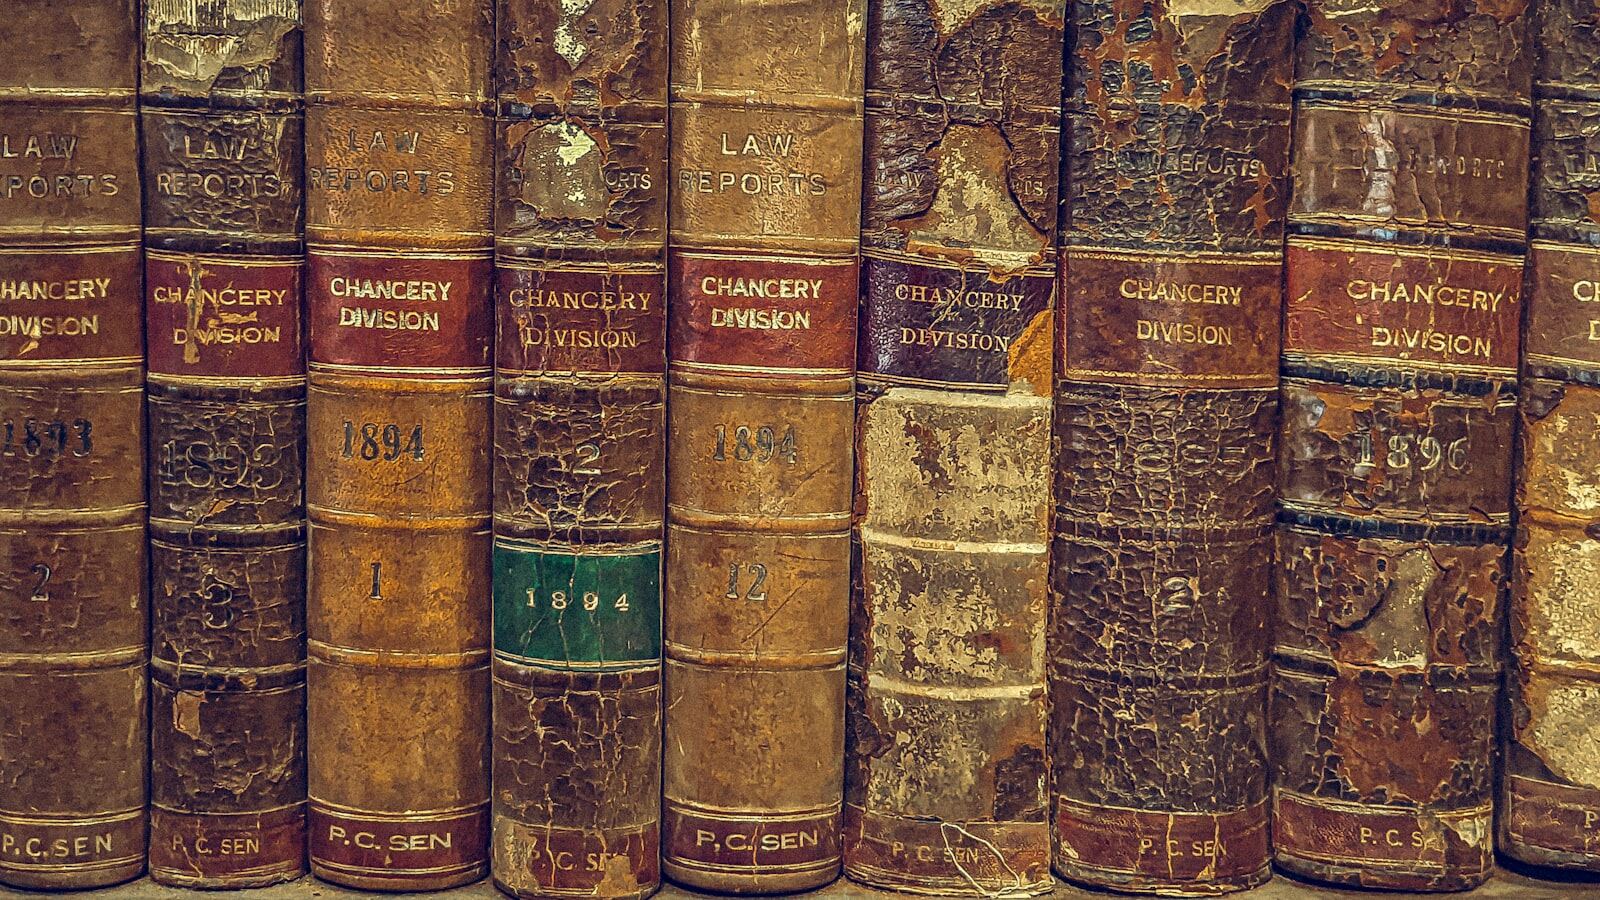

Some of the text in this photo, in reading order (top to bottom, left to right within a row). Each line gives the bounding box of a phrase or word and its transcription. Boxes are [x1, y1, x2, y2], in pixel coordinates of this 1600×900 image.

[2, 134, 78, 161] LAW
[183, 134, 250, 160] LAW
[347, 128, 421, 154] LAW
[720, 131, 796, 158] LAW
[0, 174, 118, 199] PORTS
[157, 172, 280, 198] REPORTS
[308, 167, 456, 196] REPORTS
[676, 169, 828, 196] REPORTS
[0, 278, 110, 300] HANCERY
[153, 283, 287, 306] CHANCERY
[330, 277, 453, 302] CHANCERY
[508, 289, 652, 313] CHANCERY
[701, 276, 824, 300] CHANCERY
[894, 284, 1027, 313] CHANCERY
[1119, 278, 1242, 306] CHANCERY
[1346, 279, 1503, 313] CHANCERY
[338, 306, 440, 332] DIVISION
[710, 308, 812, 331] DIVISION
[1136, 319, 1232, 346] DIVISION
[172, 326, 280, 346] DVISION
[525, 327, 638, 350] DIVISION
[899, 327, 1012, 354] DIVISION
[1370, 325, 1491, 358] DIVISION
[341, 420, 425, 463] 1894
[713, 422, 798, 466] 1894
[1353, 434, 1473, 475] 1896
[160, 439, 284, 490] 1893
[572, 442, 602, 476] 2
[30, 563, 52, 602] 2
[369, 562, 384, 600] 1
[726, 563, 769, 603] 12
[1160, 576, 1193, 612] 2
[202, 583, 234, 630] 3
[525, 587, 631, 613] 1894
[221, 838, 260, 855] SEN
[1191, 840, 1228, 857] SEN
